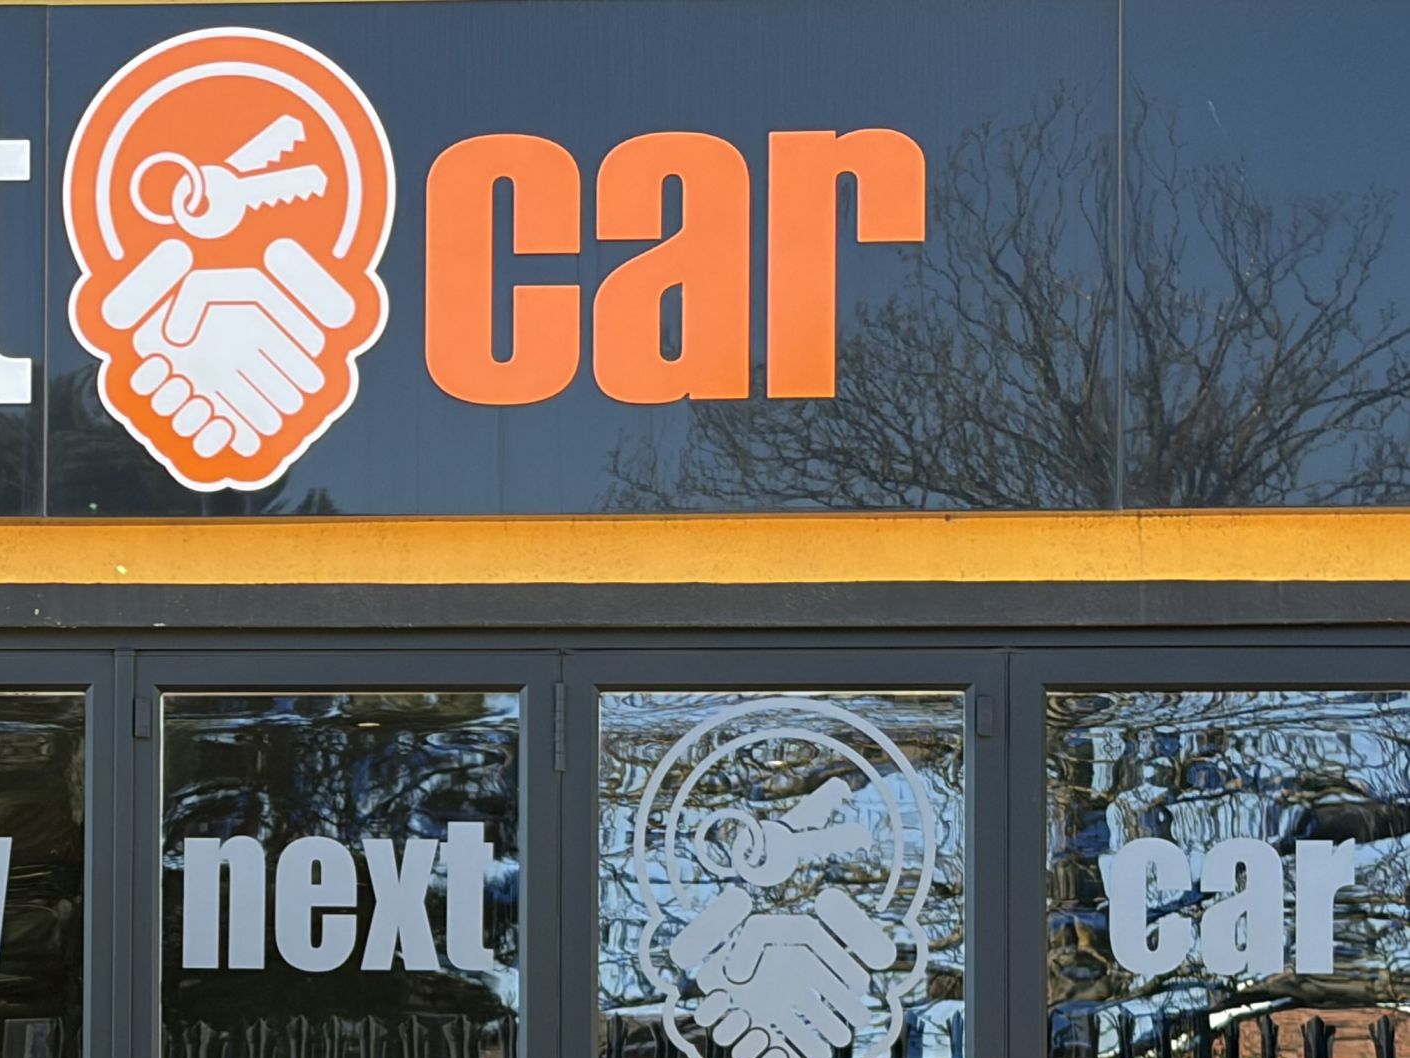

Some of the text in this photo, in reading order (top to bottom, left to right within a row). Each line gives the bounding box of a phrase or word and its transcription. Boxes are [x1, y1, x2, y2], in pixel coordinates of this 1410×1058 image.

[426, 128, 925, 405] car
[184, 821, 494, 973] next
[1109, 837, 1356, 976] car
